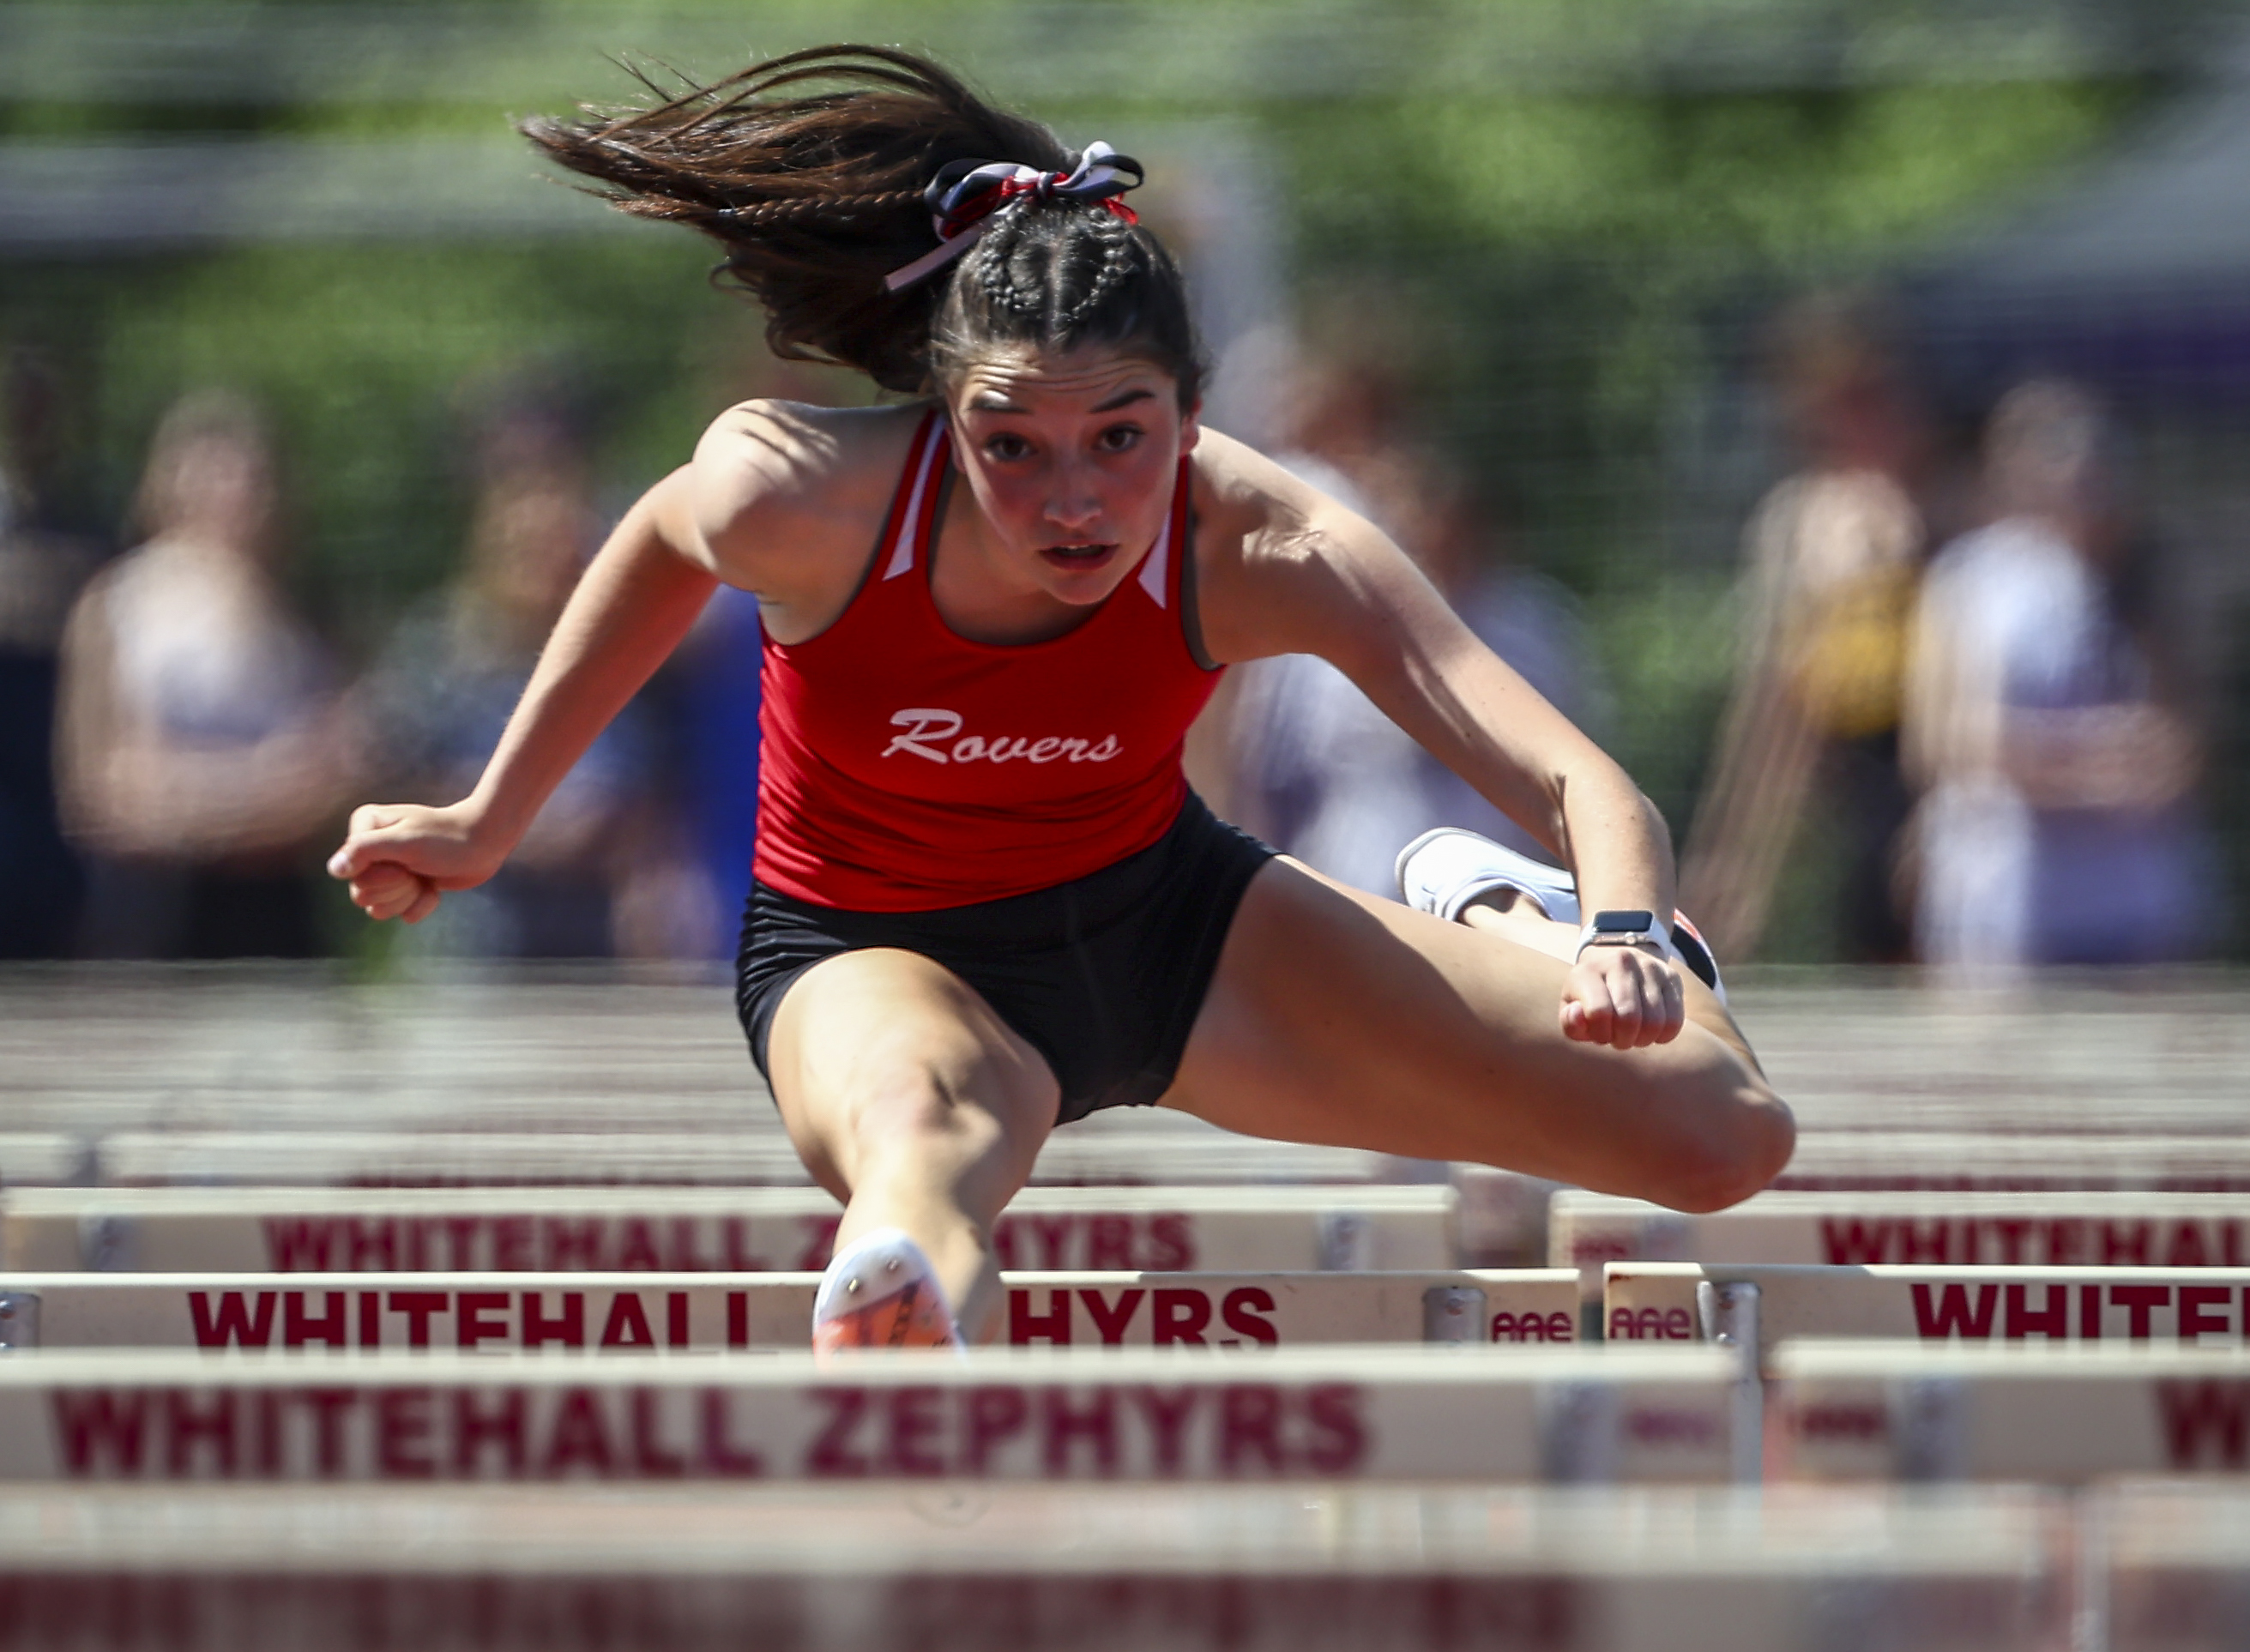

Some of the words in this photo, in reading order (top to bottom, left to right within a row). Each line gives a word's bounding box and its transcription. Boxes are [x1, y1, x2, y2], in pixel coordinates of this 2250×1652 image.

[880, 708, 1125, 764] Rovers
[51, 1386, 765, 1479] WHITEHALL
[806, 1383, 1374, 1479] ZEPHYRS
